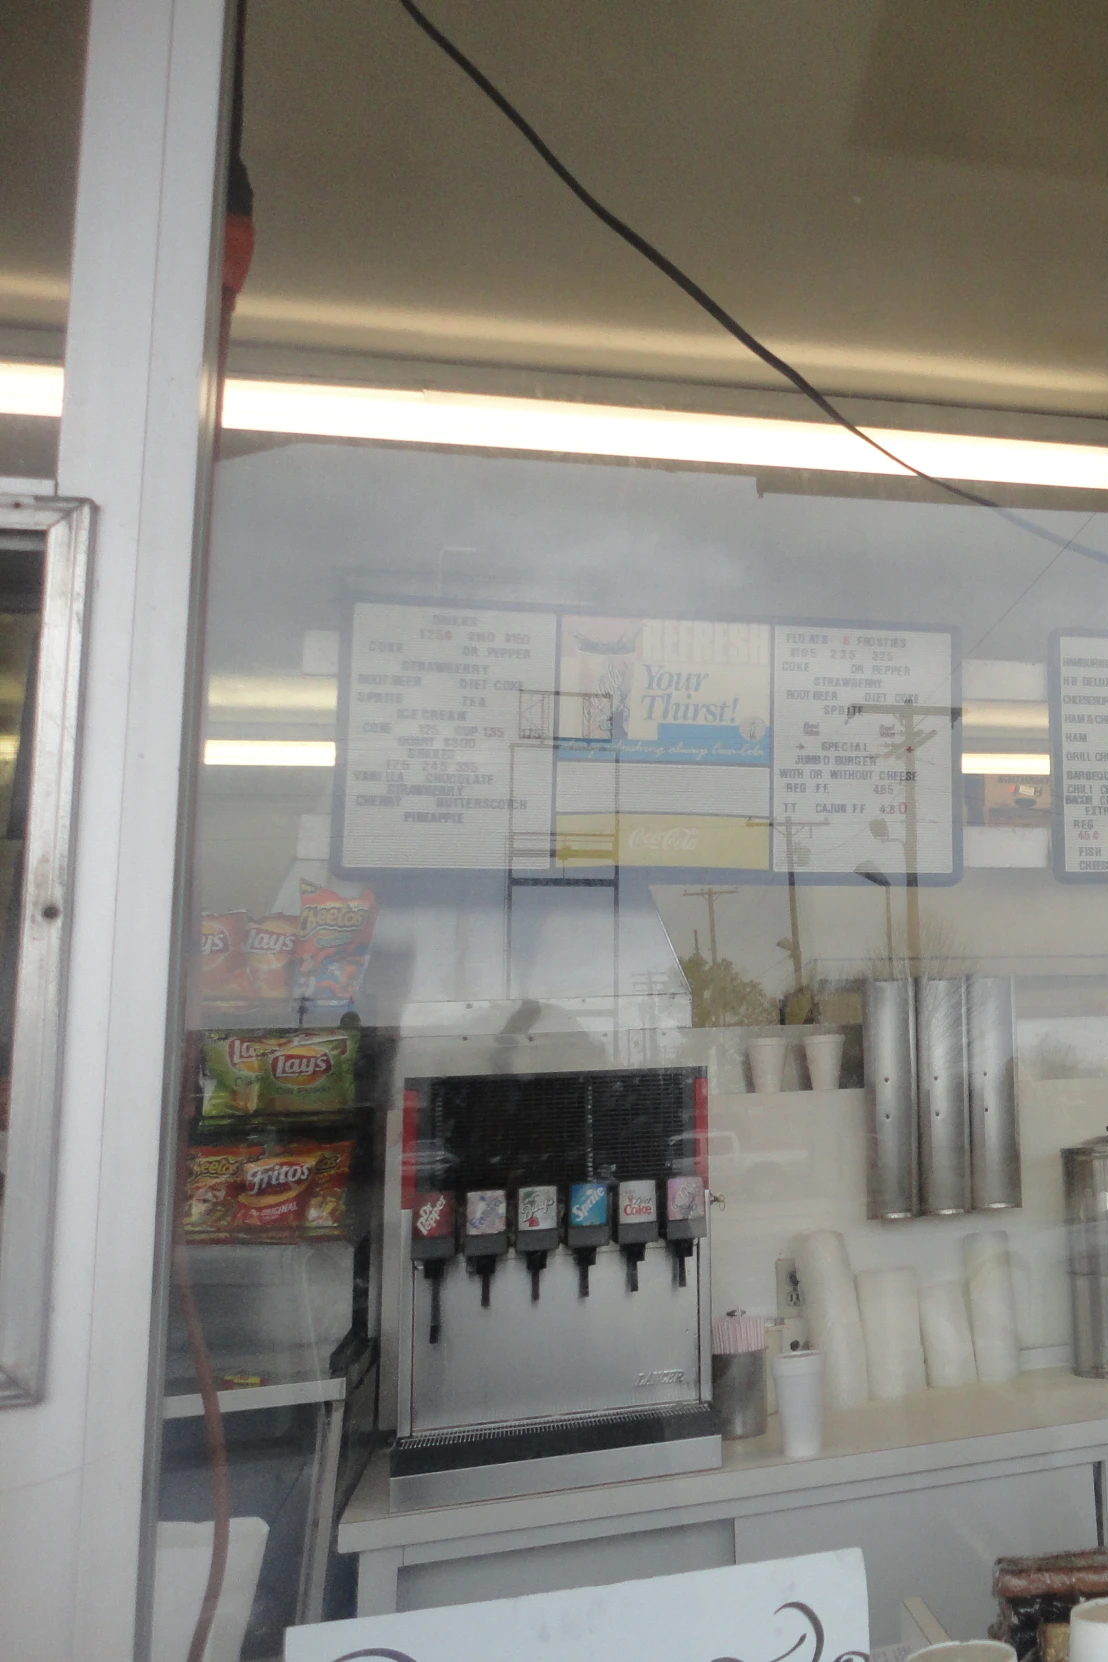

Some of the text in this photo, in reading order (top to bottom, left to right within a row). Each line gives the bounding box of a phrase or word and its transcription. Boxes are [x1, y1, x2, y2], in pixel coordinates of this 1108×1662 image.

[857, 637, 906, 648] FROSTIES
[369, 641, 403, 653] COKE
[487, 648, 531, 659] PEPPER
[401, 660, 489, 674] STRAWBERRY
[782, 662, 910, 676] COKE DR PEPPER
[642, 663, 709, 692] Your
[814, 677, 883, 688] STRAWBERRY
[459, 679, 487, 690] DIET
[493, 680, 524, 691] COKE
[462, 696, 486, 707] TEA
[786, 690, 920, 703] ROOT BEER DIET COKE
[641, 694, 739, 723] Thirst!
[824, 705, 864, 716] SPRITE
[398, 709, 468, 722] ICE CREAM
[1065, 714, 1085, 723] HAM
[1087, 715, 1094, 724] &
[1065, 733, 1087, 742] HAM
[821, 742, 868, 752] SPECIAL
[408, 749, 455, 759] SHAKES
[1066, 752, 1091, 761] GRILL
[795, 755, 877, 766] JUMBO BURGER
[425, 774, 494, 784] CHOCOLATE
[779, 769, 917, 781] WITH OR WITHOUT CHEESE
[387, 784, 463, 796] STRAWBERRY
[786, 783, 806, 793] REG
[1067, 785, 1092, 794] CHILI
[436, 798, 527, 809] BUTTERSCOTCH
[1066, 796, 1092, 804] BACON
[783, 803, 865, 814] TT CAJUN FF
[404, 812, 464, 823] PINEAPPLE
[1073, 820, 1094, 829] REG
[628, 827, 699, 850] Coca-Cola
[1079, 847, 1102, 856] FISH
[247, 1163, 309, 1195] Fritos
[571, 1187, 605, 1222] Sprite
[633, 1196, 652, 1205] Diet
[261, 1202, 298, 1216] ORIGINAL
[419, 1202, 433, 1218] Dr
[623, 1203, 652, 1217] Coke
[416, 1195, 446, 1236] Pepper
